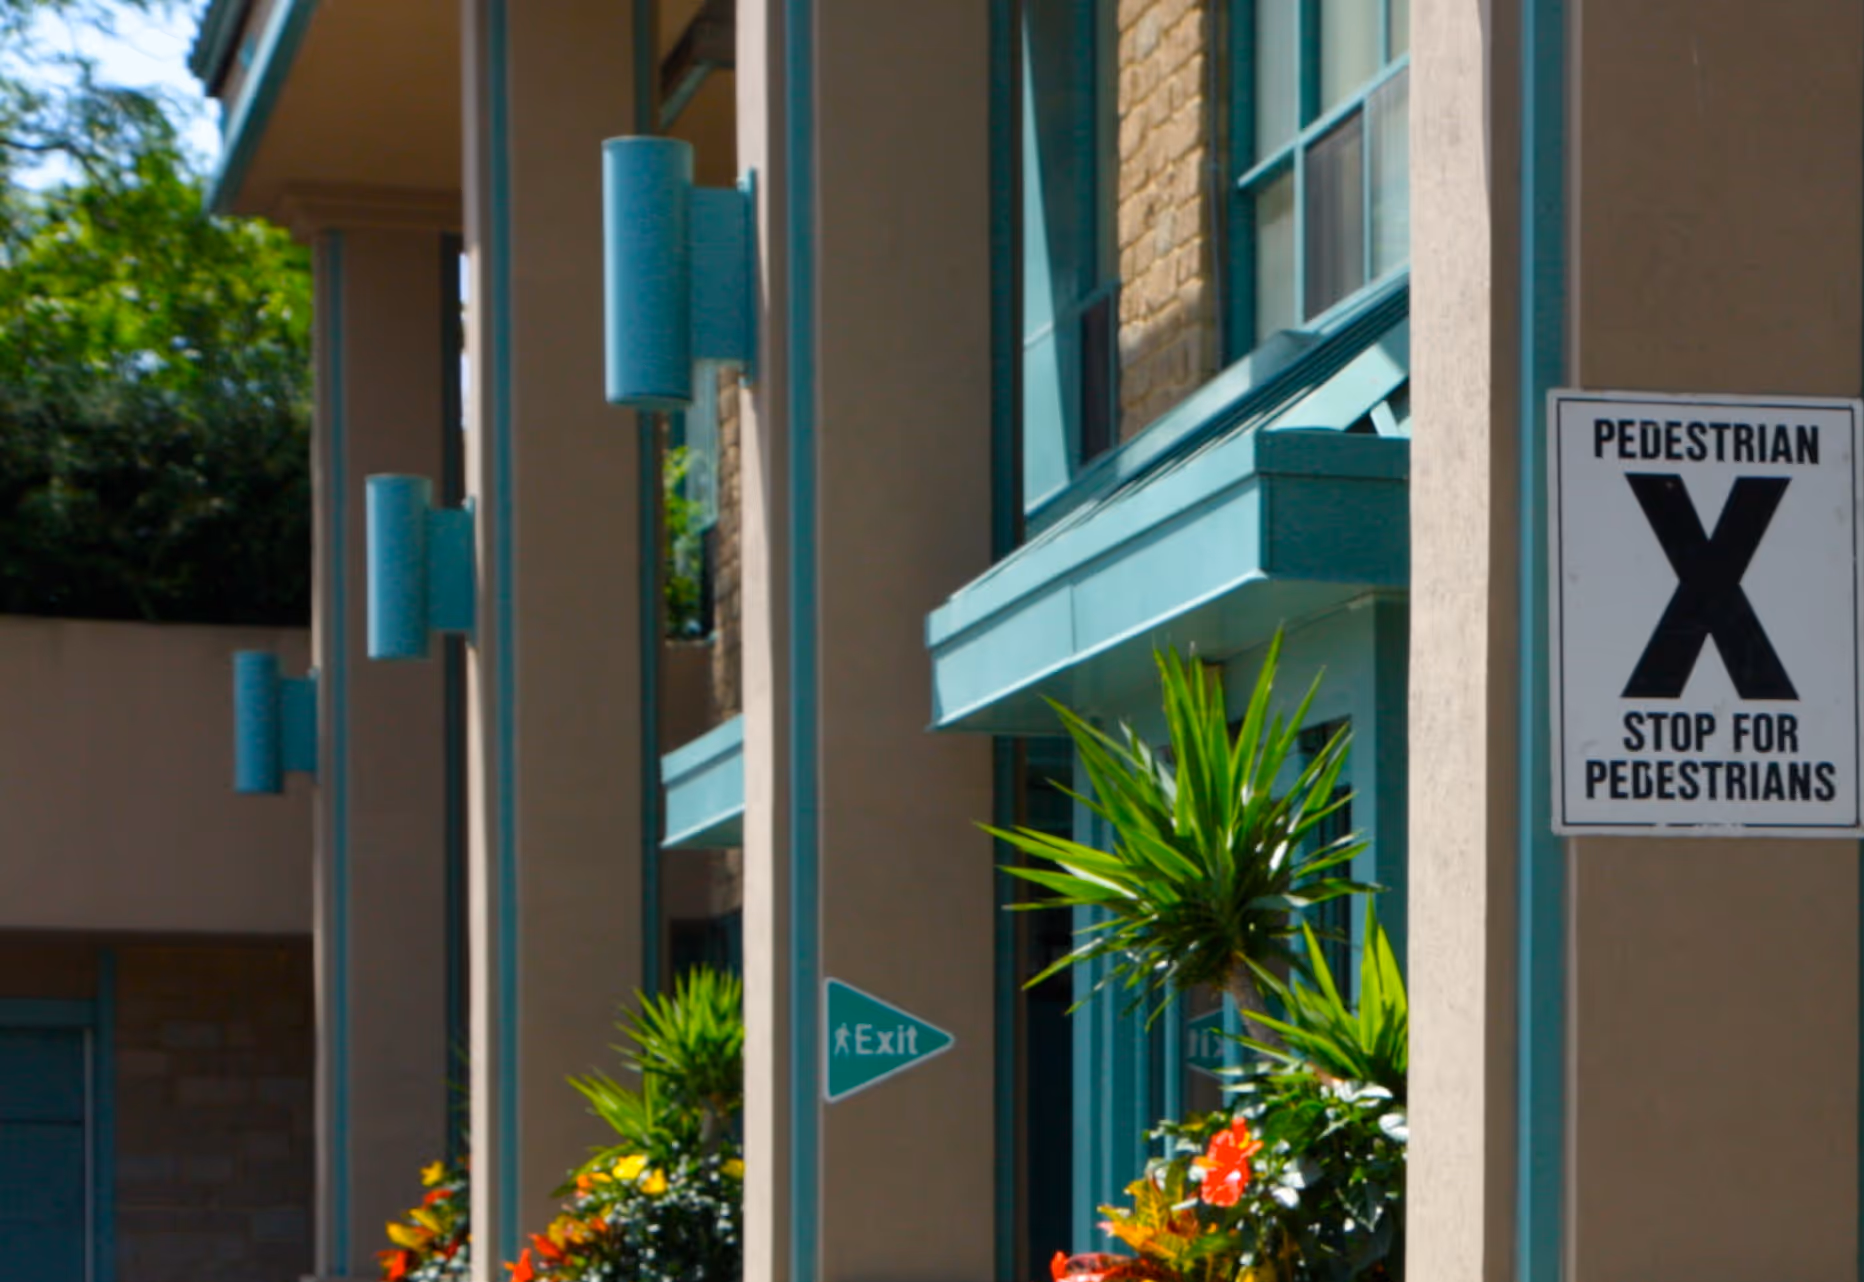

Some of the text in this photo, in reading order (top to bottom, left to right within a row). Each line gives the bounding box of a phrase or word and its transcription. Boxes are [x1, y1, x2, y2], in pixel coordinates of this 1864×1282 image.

[1594, 419, 1819, 464] PEDESTRIAN
[1620, 473, 1799, 700] X
[1623, 712, 1798, 753] STOP FOR
[1586, 760, 1836, 801] PEDESTRIANS
[855, 1023, 919, 1055] Exit
